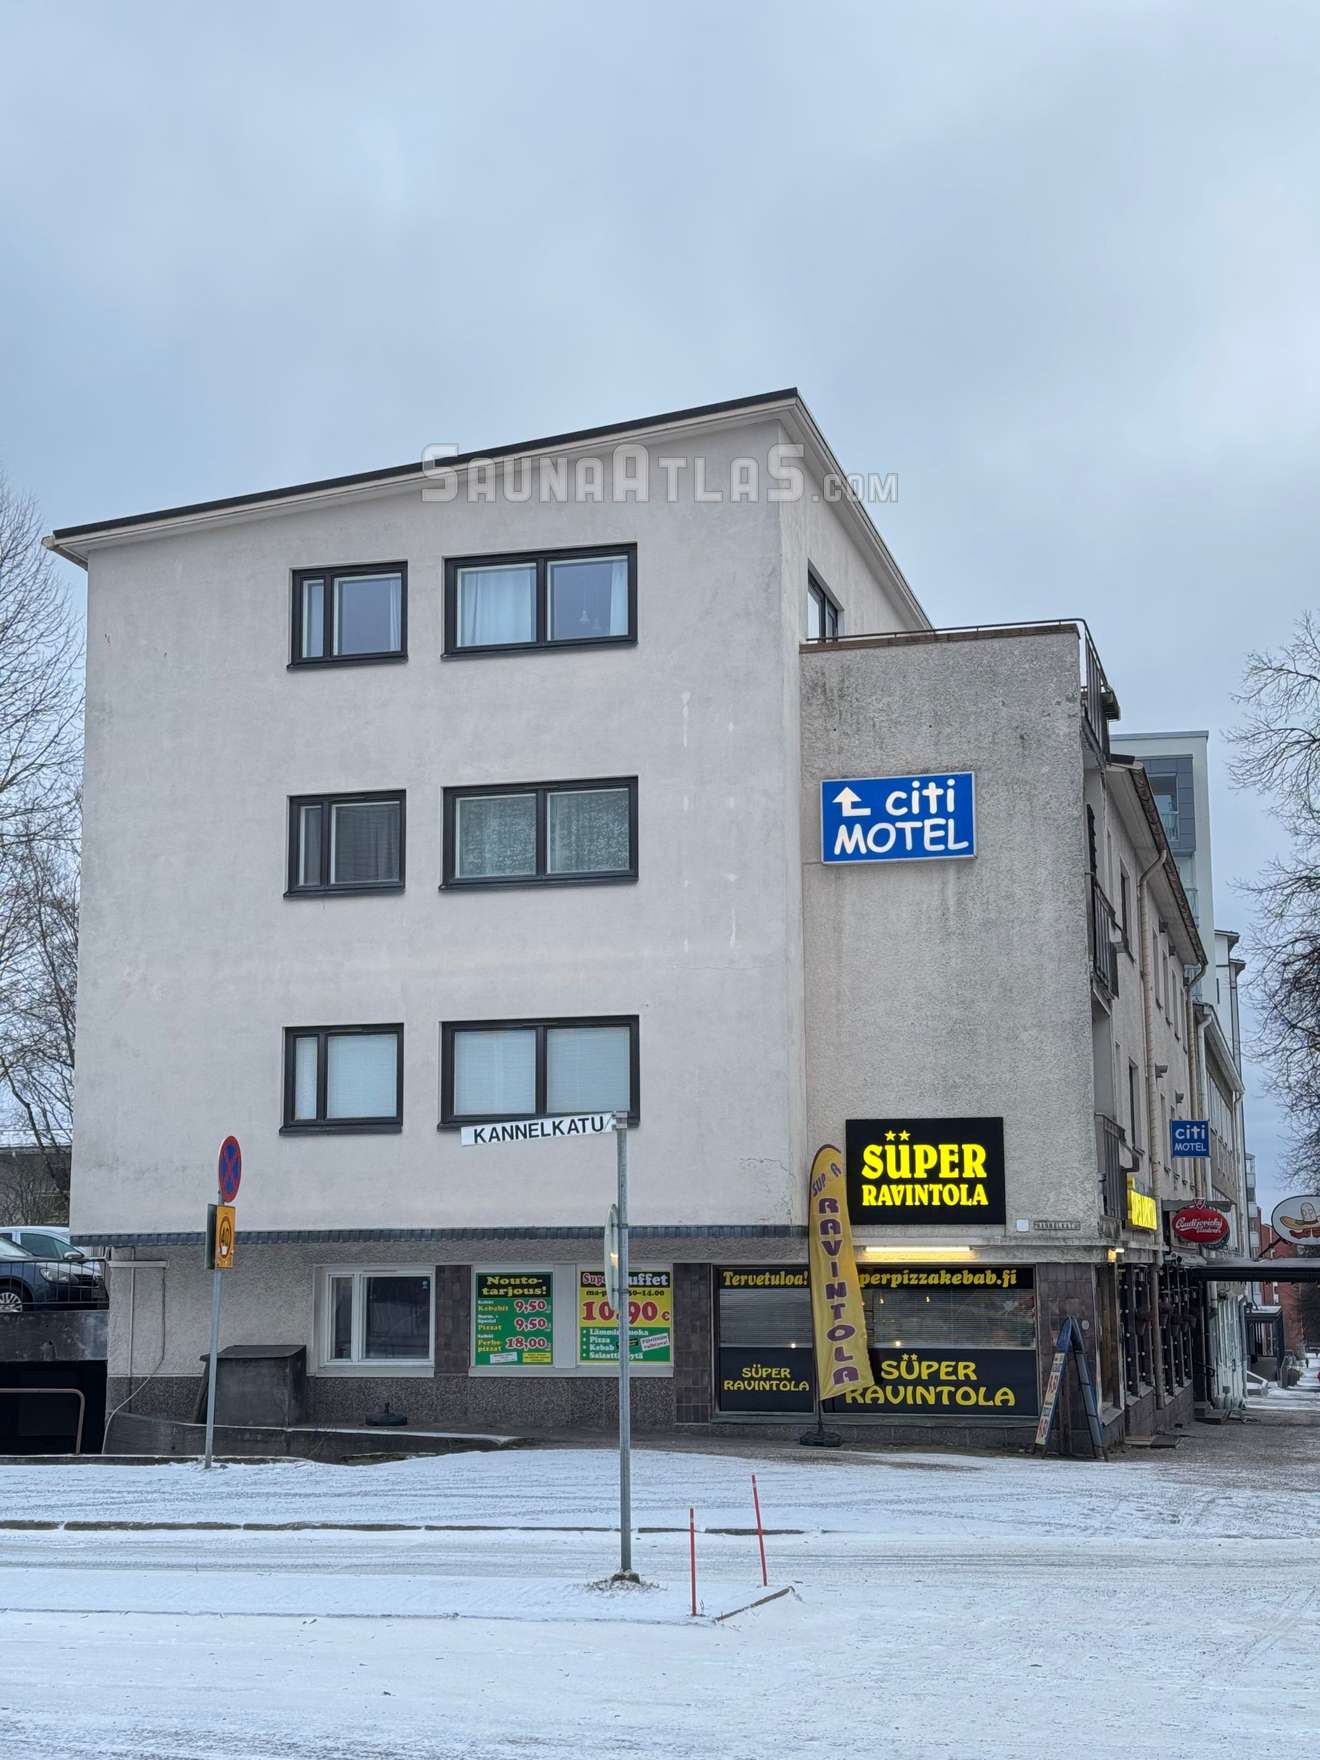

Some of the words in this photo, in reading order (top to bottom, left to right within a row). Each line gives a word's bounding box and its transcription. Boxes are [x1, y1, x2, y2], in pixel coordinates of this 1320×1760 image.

[885, 778, 956, 816] citi
[834, 818, 970, 855] MOTEL
[473, 1116, 605, 1144] KANNELKATU
[1174, 1124, 1206, 1140] citi
[861, 1129, 988, 1179] SÜPER
[1174, 1142, 1207, 1152] MOTEL
[862, 1184, 989, 1206] RAVINTOLA
[486, 1276, 543, 1285] Nouto-
[628, 1273, 669, 1286] uffet
[722, 1270, 809, 1287] Tervetuloa!
[858, 1269, 1018, 1288] perpizzakebab.fi
[481, 1286, 547, 1297] tarjous!
[818, 1197, 860, 1385] RAVINTOLA
[514, 1299, 548, 1314] 9,50
[582, 1300, 658, 1326] 1090
[514, 1317, 548, 1332] 9,50
[505, 1335, 548, 1351] 18,00
[742, 1364, 792, 1378] SÜPER
[881, 1353, 978, 1381] SÜPER
[723, 1380, 810, 1391] RAVINTOLA
[845, 1385, 1016, 1407] RAVINTOLA
